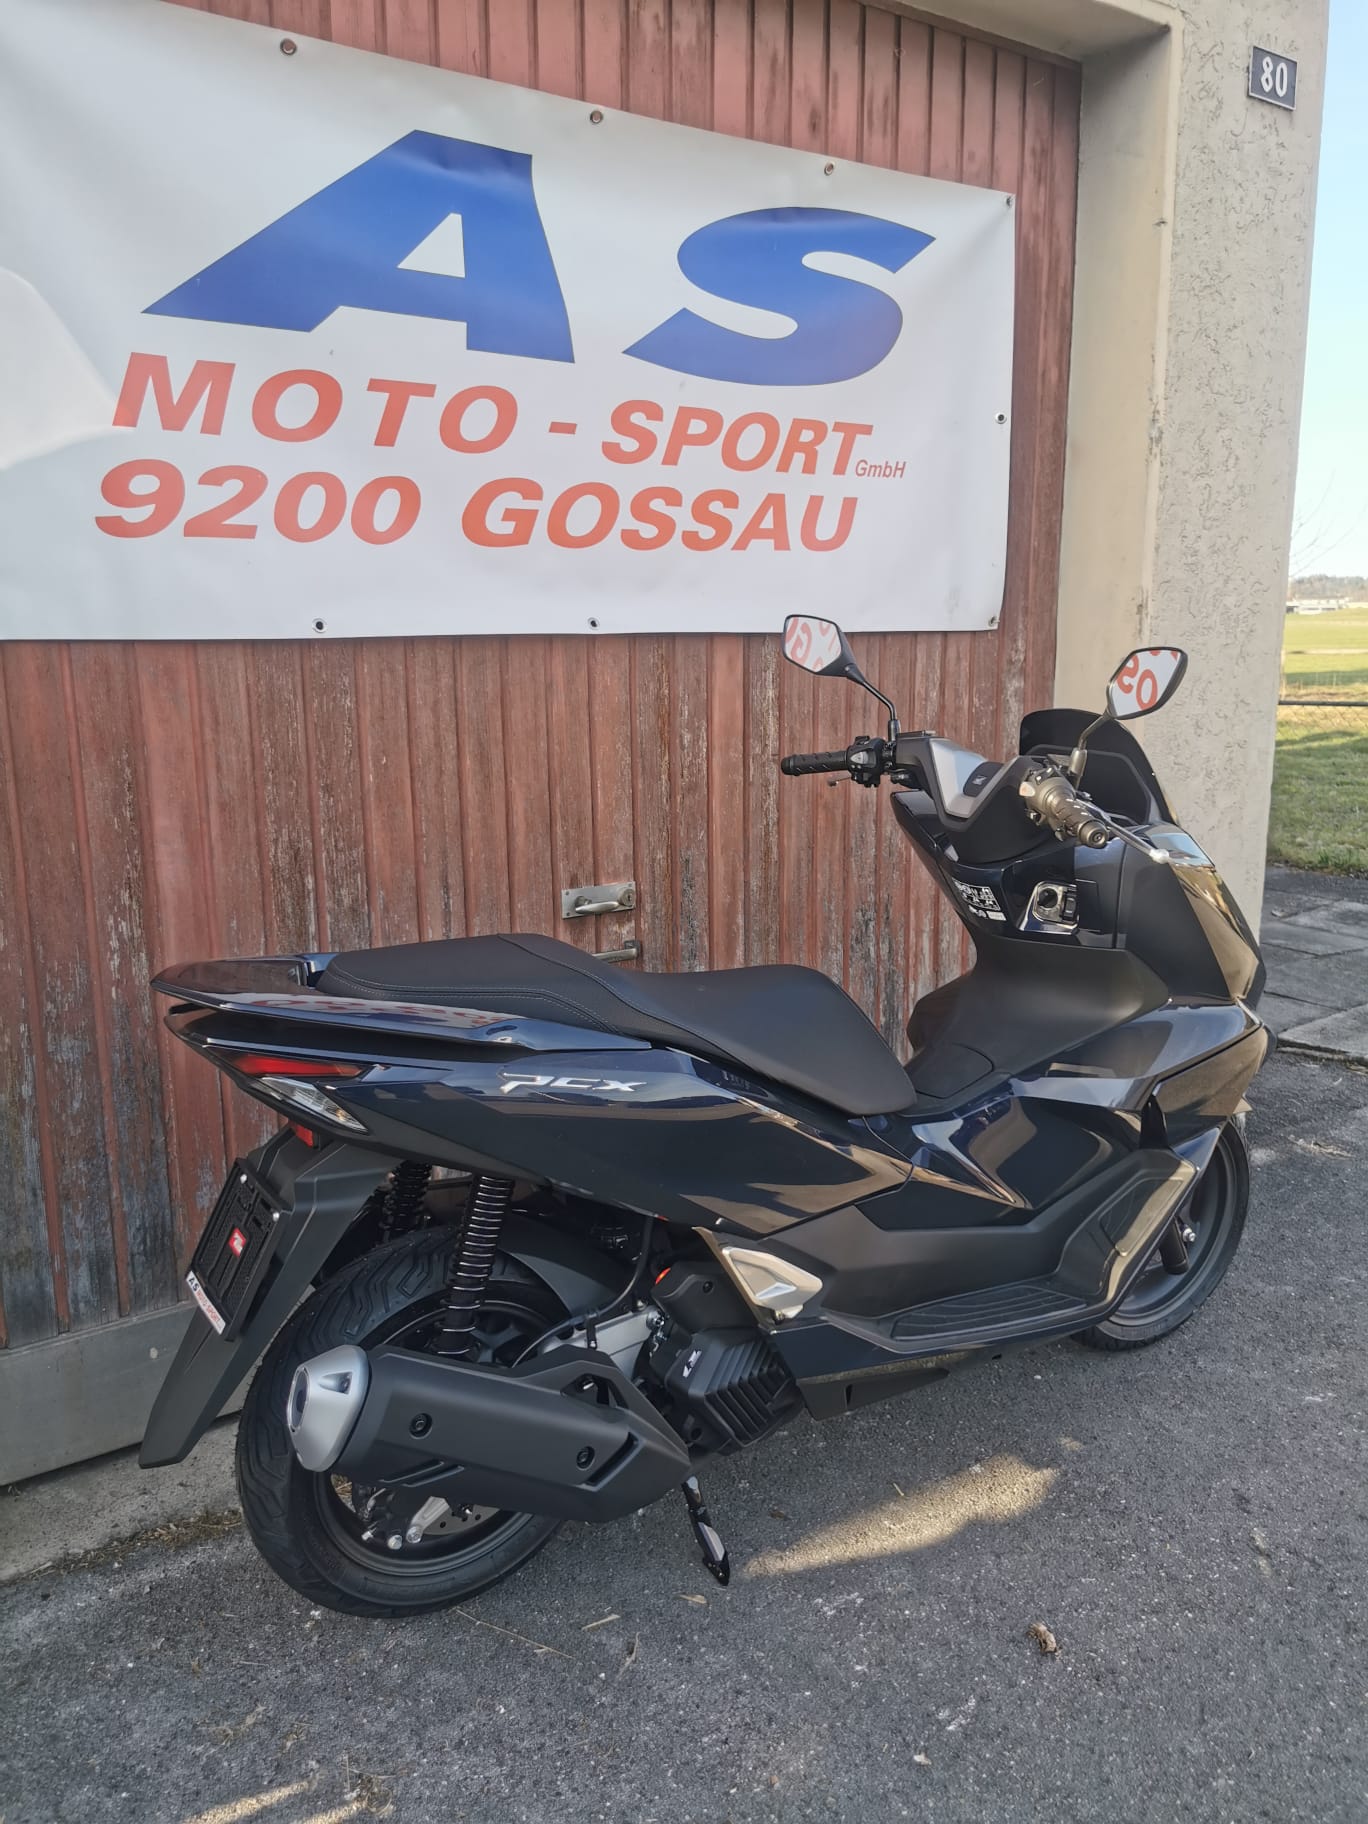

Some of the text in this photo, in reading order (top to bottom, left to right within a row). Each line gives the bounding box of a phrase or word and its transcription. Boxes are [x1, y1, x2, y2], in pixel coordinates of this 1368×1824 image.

[1261, 56, 1288, 97] 80
[111, 352, 518, 455] MOTO
[601, 399, 873, 476] SPORT
[855, 459, 907, 479] GmbH
[95, 459, 858, 552] 9200 GOSSAU
[500, 1072, 647, 1094] PCX
